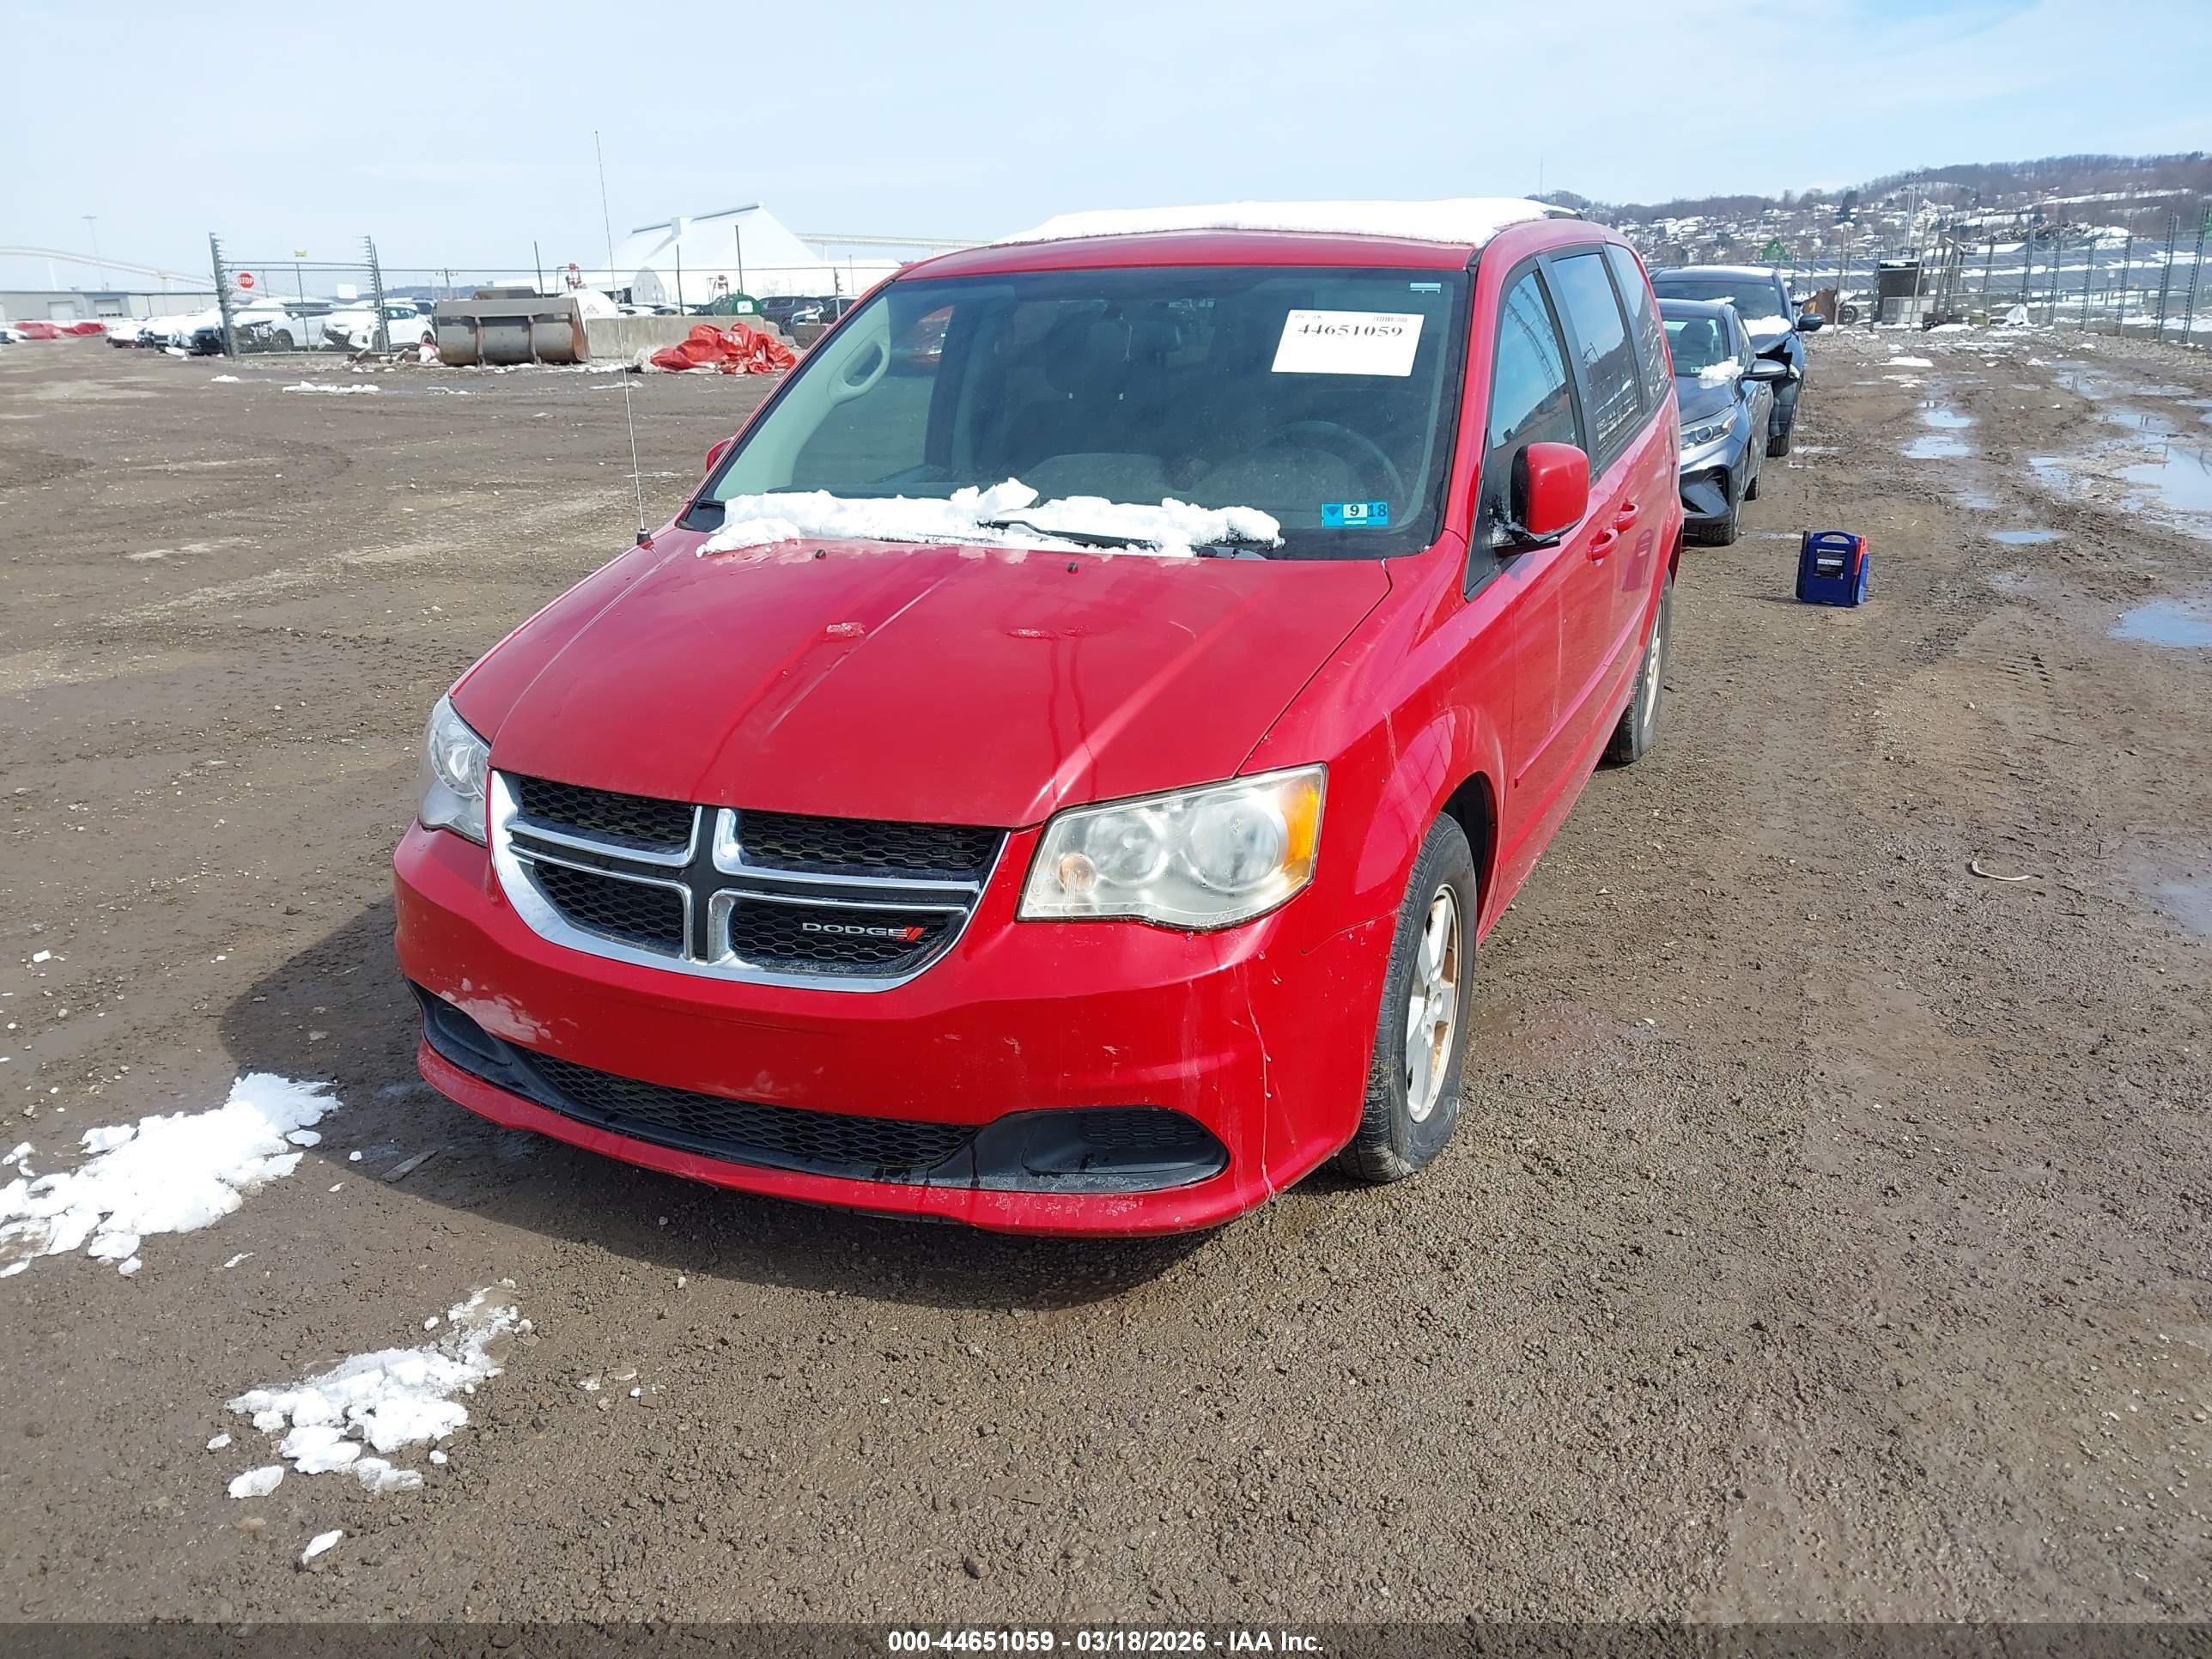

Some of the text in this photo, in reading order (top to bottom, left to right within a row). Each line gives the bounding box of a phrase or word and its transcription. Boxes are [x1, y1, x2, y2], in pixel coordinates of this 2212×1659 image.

[1297, 324, 1403, 337] 44651059
[1349, 503, 1387, 517] 9 18
[802, 922, 908, 938] DODGE
